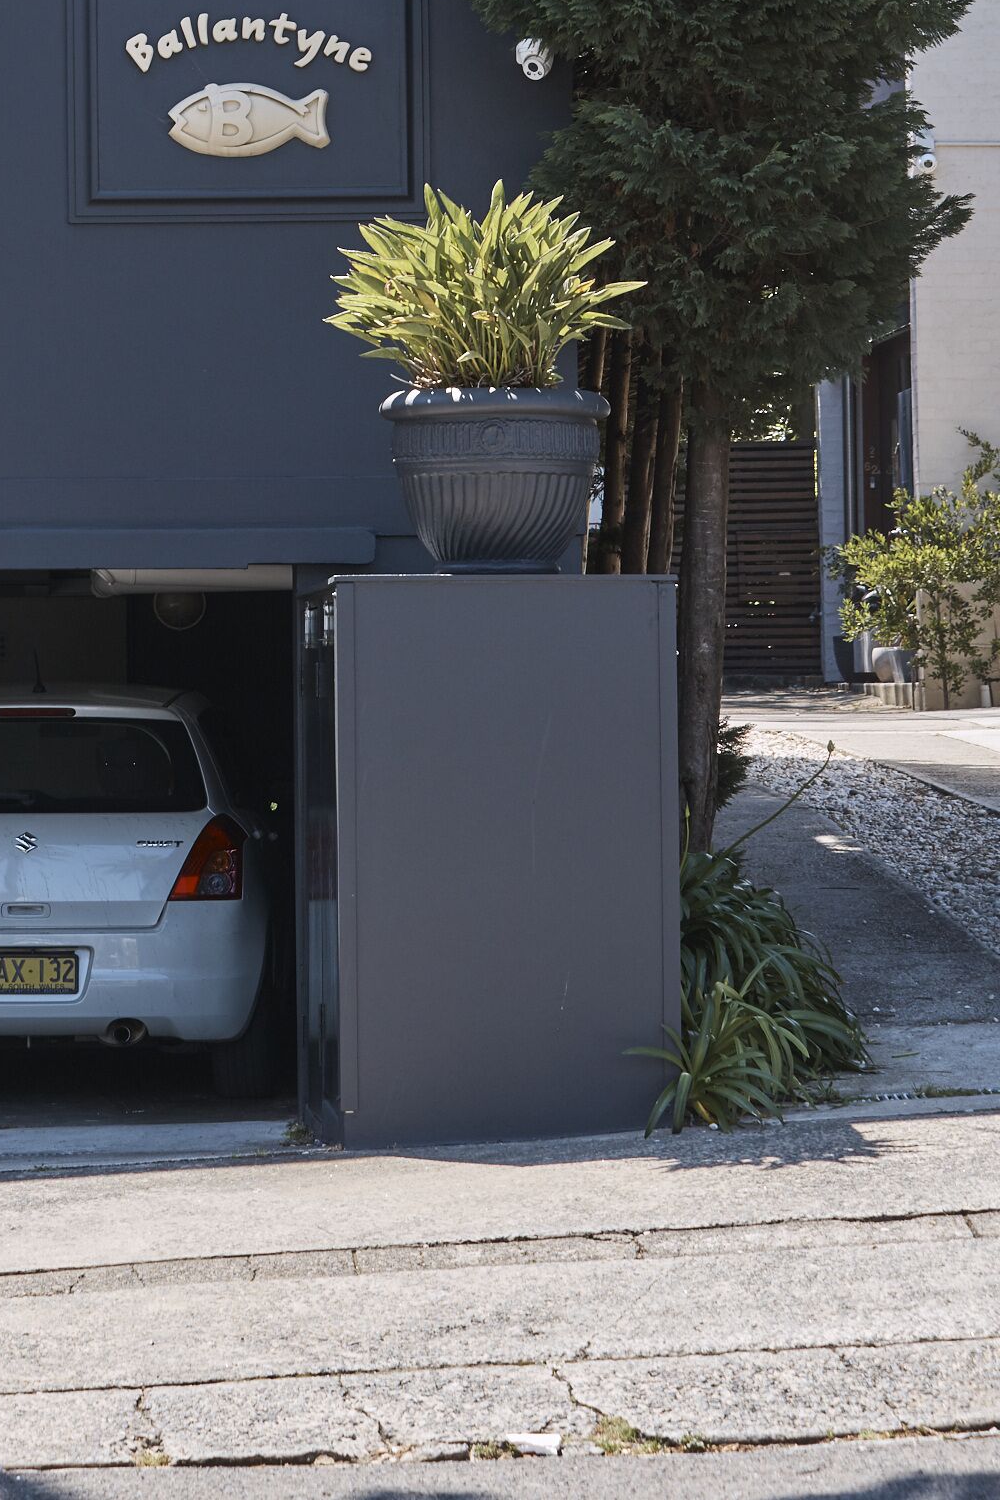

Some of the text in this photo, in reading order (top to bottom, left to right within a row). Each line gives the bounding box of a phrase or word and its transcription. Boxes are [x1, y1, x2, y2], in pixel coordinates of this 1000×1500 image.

[125, 12, 373, 73] Ballantyne
[209, 89, 254, 148] B
[136, 840, 184, 848] SWIFT
